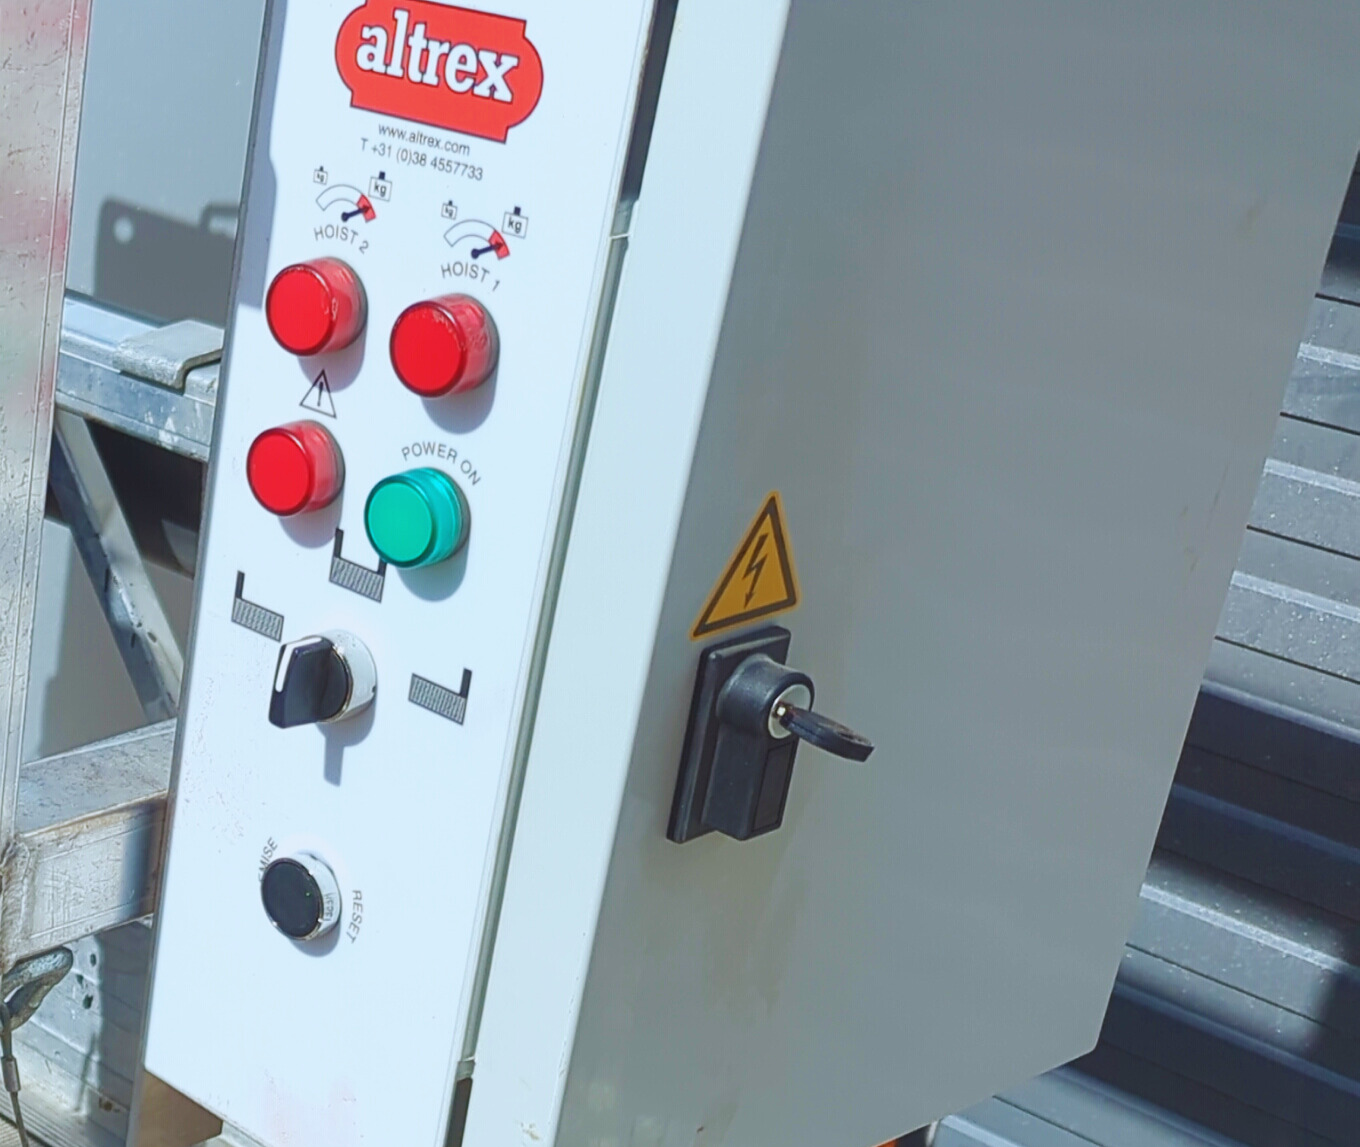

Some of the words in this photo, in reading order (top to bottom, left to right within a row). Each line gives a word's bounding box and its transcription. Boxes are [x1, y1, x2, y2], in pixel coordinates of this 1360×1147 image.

[356, 7, 520, 104] altrex
[378, 123, 471, 156] www.altrex.com
[360, 137, 369, 152] T
[371, 142, 393, 159] +31
[396, 147, 428, 167] (0)38
[430, 156, 484, 182] 4557733
[373, 182, 388, 197] kg
[313, 224, 359, 244] HOIST
[359, 240, 370, 255] 2
[508, 216, 523, 234] kg
[440, 260, 491, 283] HOIST
[491, 279, 501, 292] 1
[401, 441, 458, 464] POWER
[460, 459, 482, 486] ON
[346, 889, 364, 945] RESET
